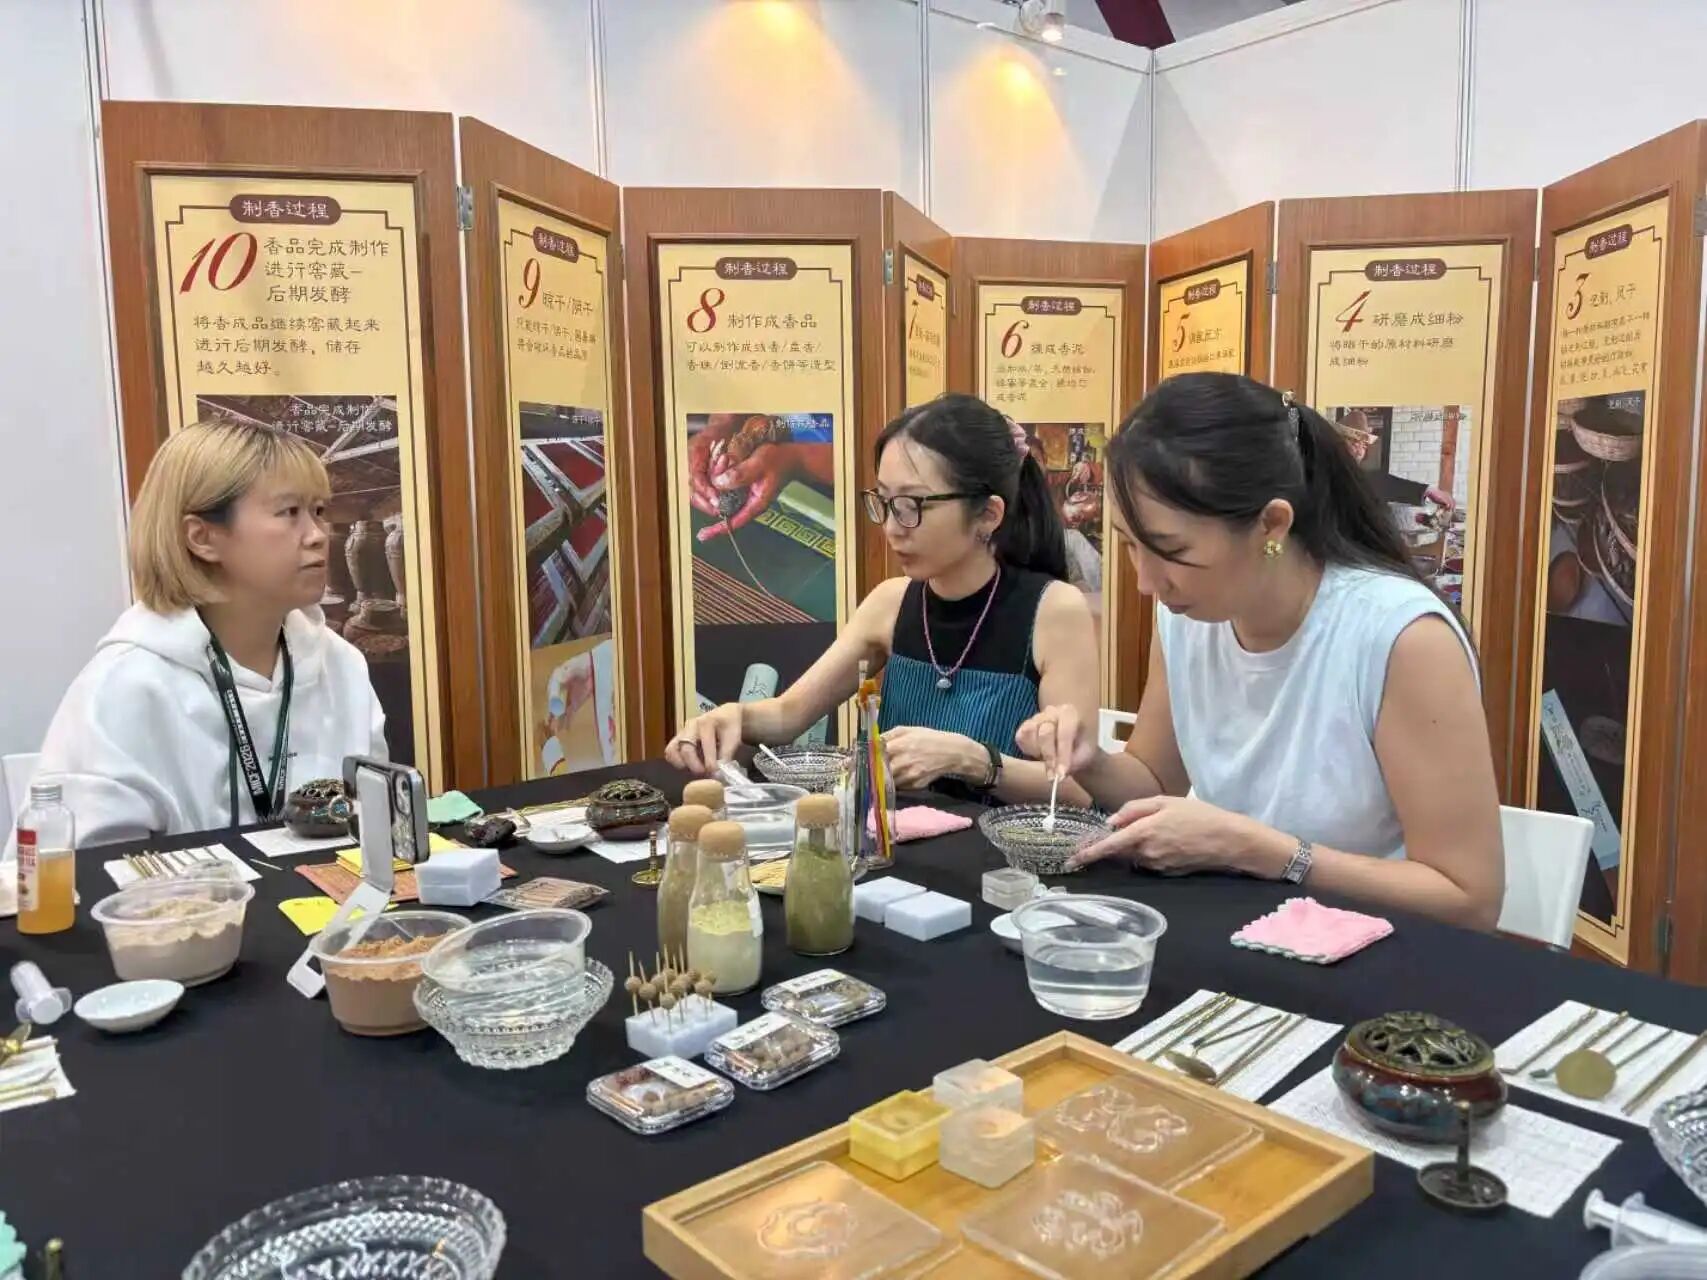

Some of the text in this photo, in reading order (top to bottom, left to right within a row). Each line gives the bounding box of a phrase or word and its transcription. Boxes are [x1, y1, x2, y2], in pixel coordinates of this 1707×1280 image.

[241, 200, 330, 219] 制香过程
[263, 237, 390, 257] 香品完成制作
[179, 232, 258, 295] 10
[724, 261, 788, 277] 制香过程
[1374, 263, 1437, 277] 制香过程
[518, 258, 541, 310] 9
[266, 285, 352, 304] 后期发酵
[1566, 273, 1591, 320] 3
[686, 287, 726, 333] 8
[1335, 290, 1371, 333] 4
[1373, 311, 1464, 327] 研磨成细粉
[193, 315, 381, 332] 将香成品继续窖藏起来
[727, 312, 818, 330] 制作成香品
[1001, 319, 1030, 359] 6
[1172, 312, 1192, 352] 5
